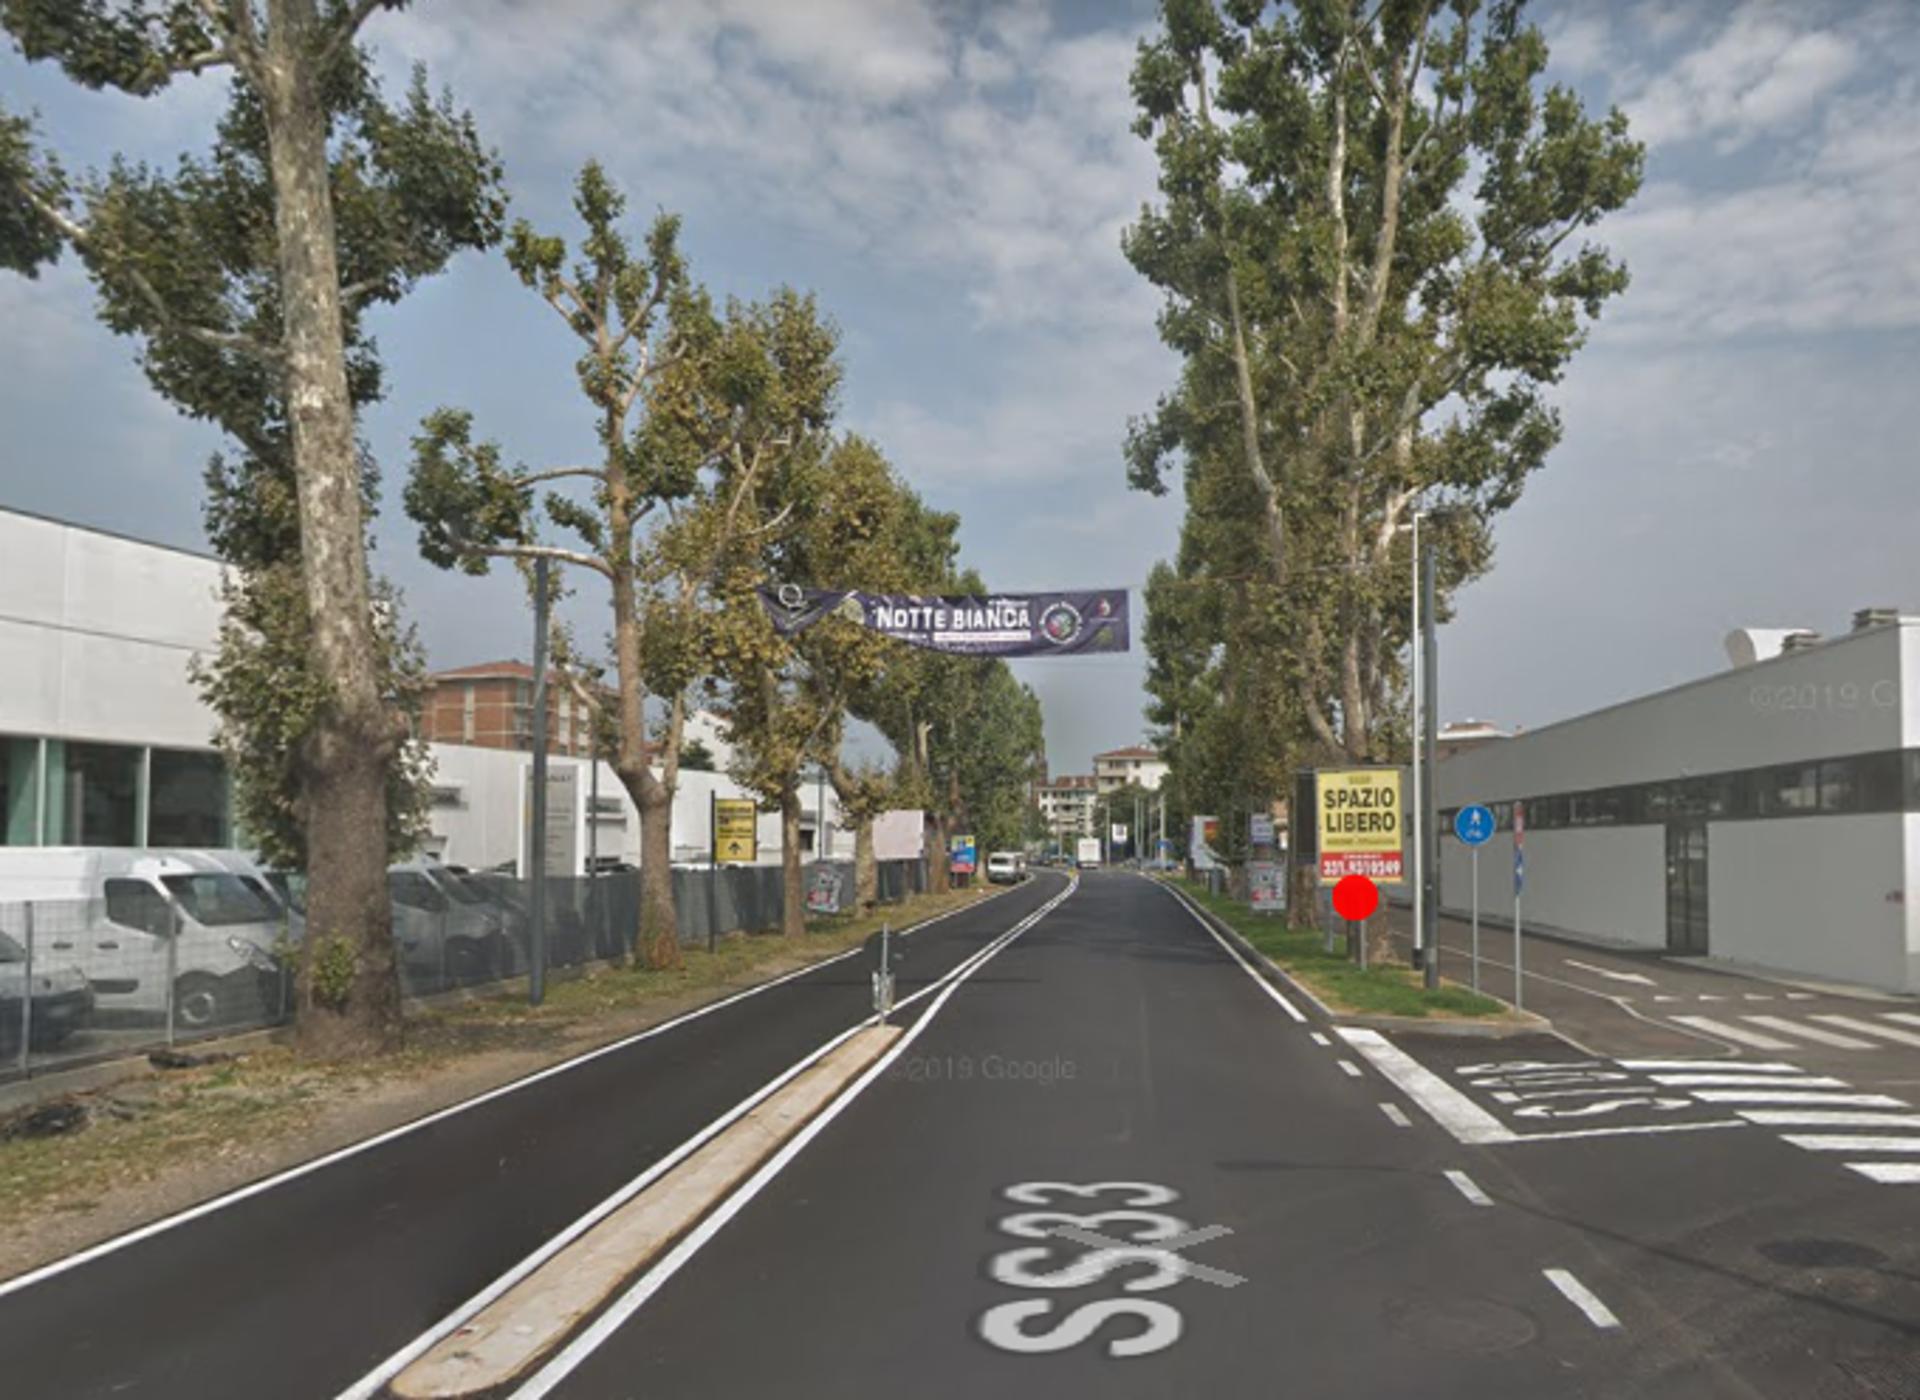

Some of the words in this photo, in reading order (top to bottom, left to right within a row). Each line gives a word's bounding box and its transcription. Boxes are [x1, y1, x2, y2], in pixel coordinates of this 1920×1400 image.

[877, 606, 946, 629] NOTTE
[952, 607, 1031, 630] BIANCA
[1324, 787, 1395, 809] SPAZIO
[1326, 811, 1396, 833] LIBERO
[1454, 1060, 1692, 1117] STOP
[981, 1181, 1191, 1357] SS33
